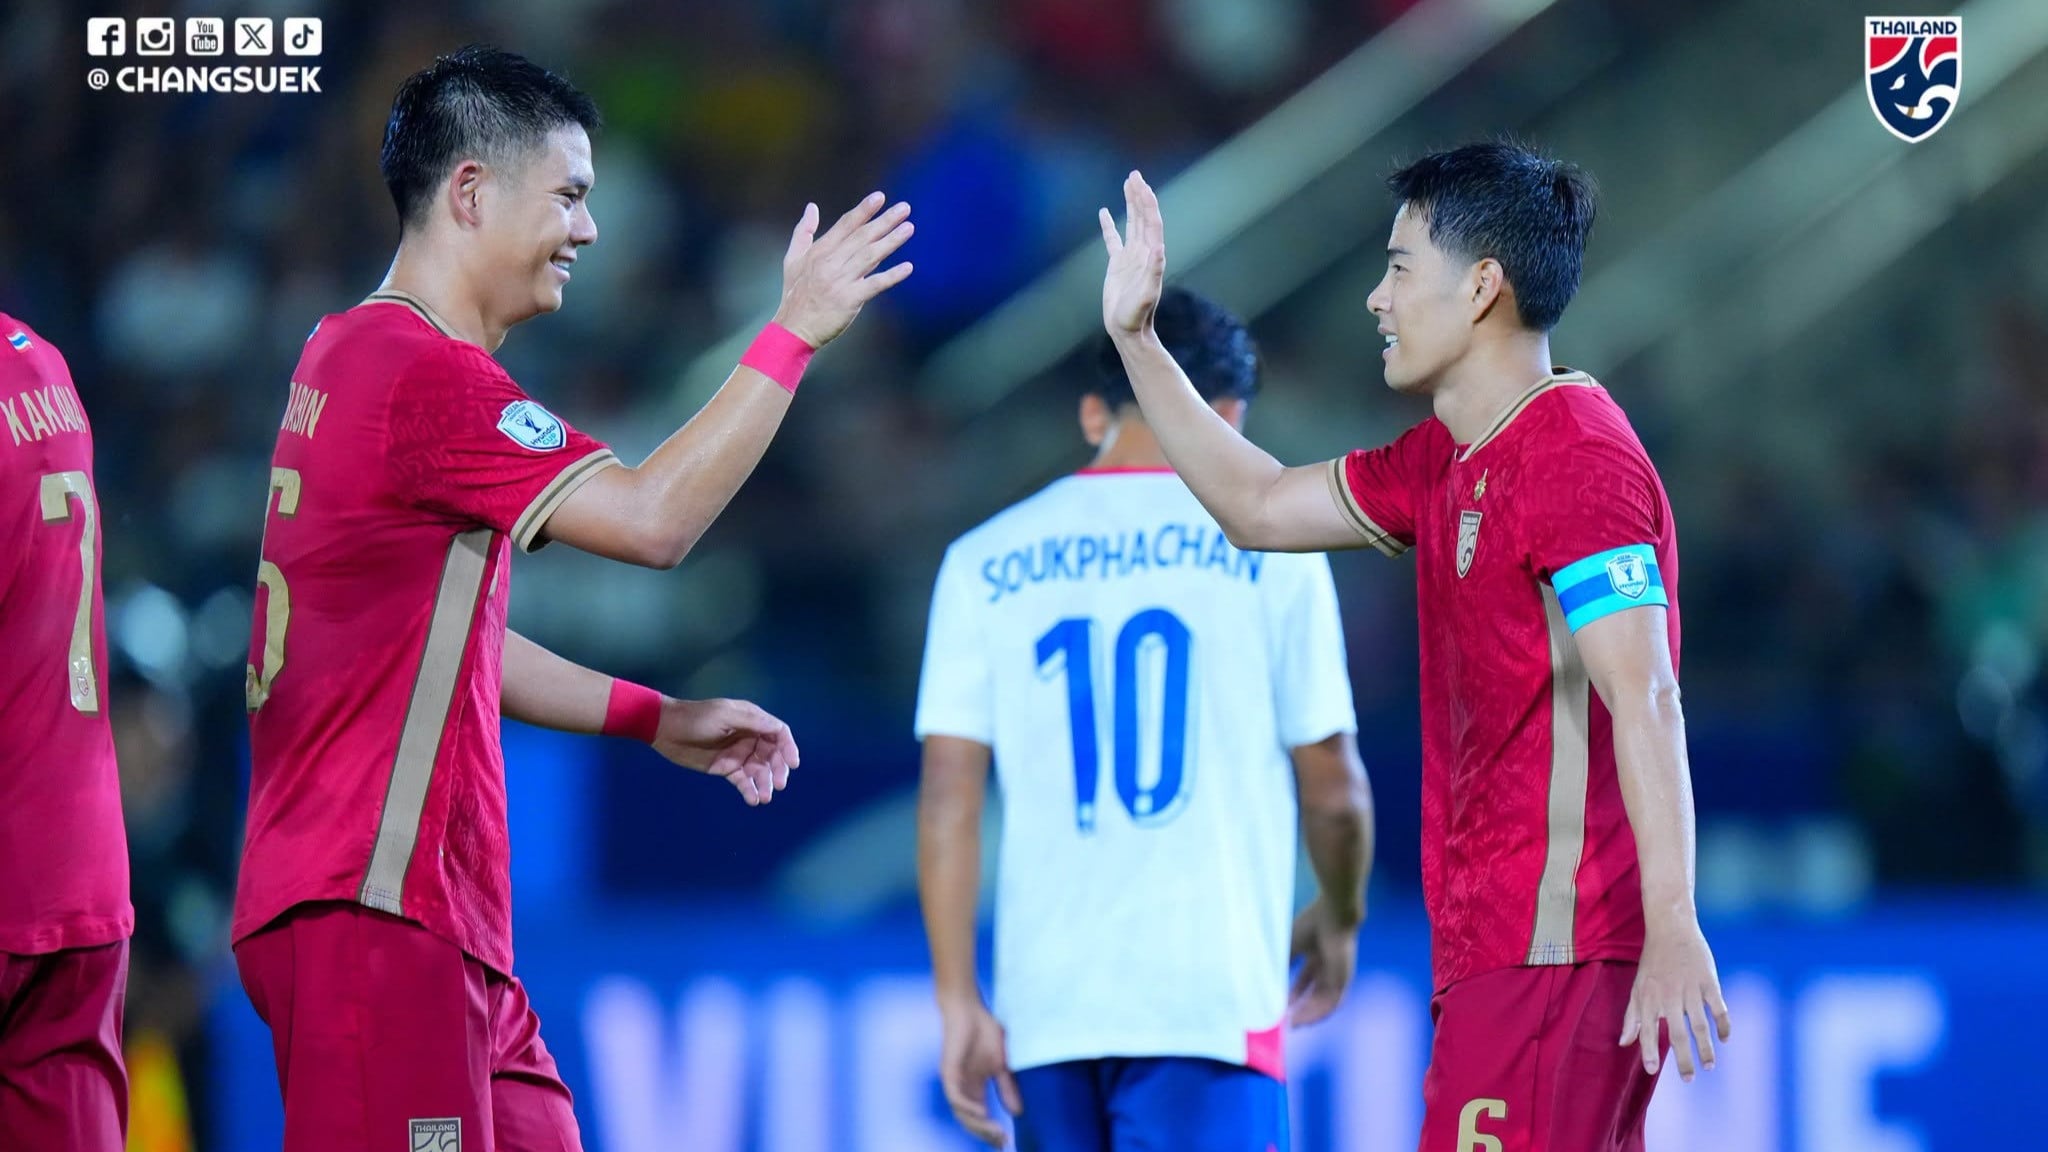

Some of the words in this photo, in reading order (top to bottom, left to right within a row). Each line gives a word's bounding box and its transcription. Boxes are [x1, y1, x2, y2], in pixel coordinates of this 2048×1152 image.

[40, 470, 98, 712] 7
[982, 524, 1264, 603] SOUKPHACHAN
[1035, 608, 1195, 833] 10
[414, 1123, 457, 1132] THAILAND
[1457, 1097, 1507, 1152] 6
